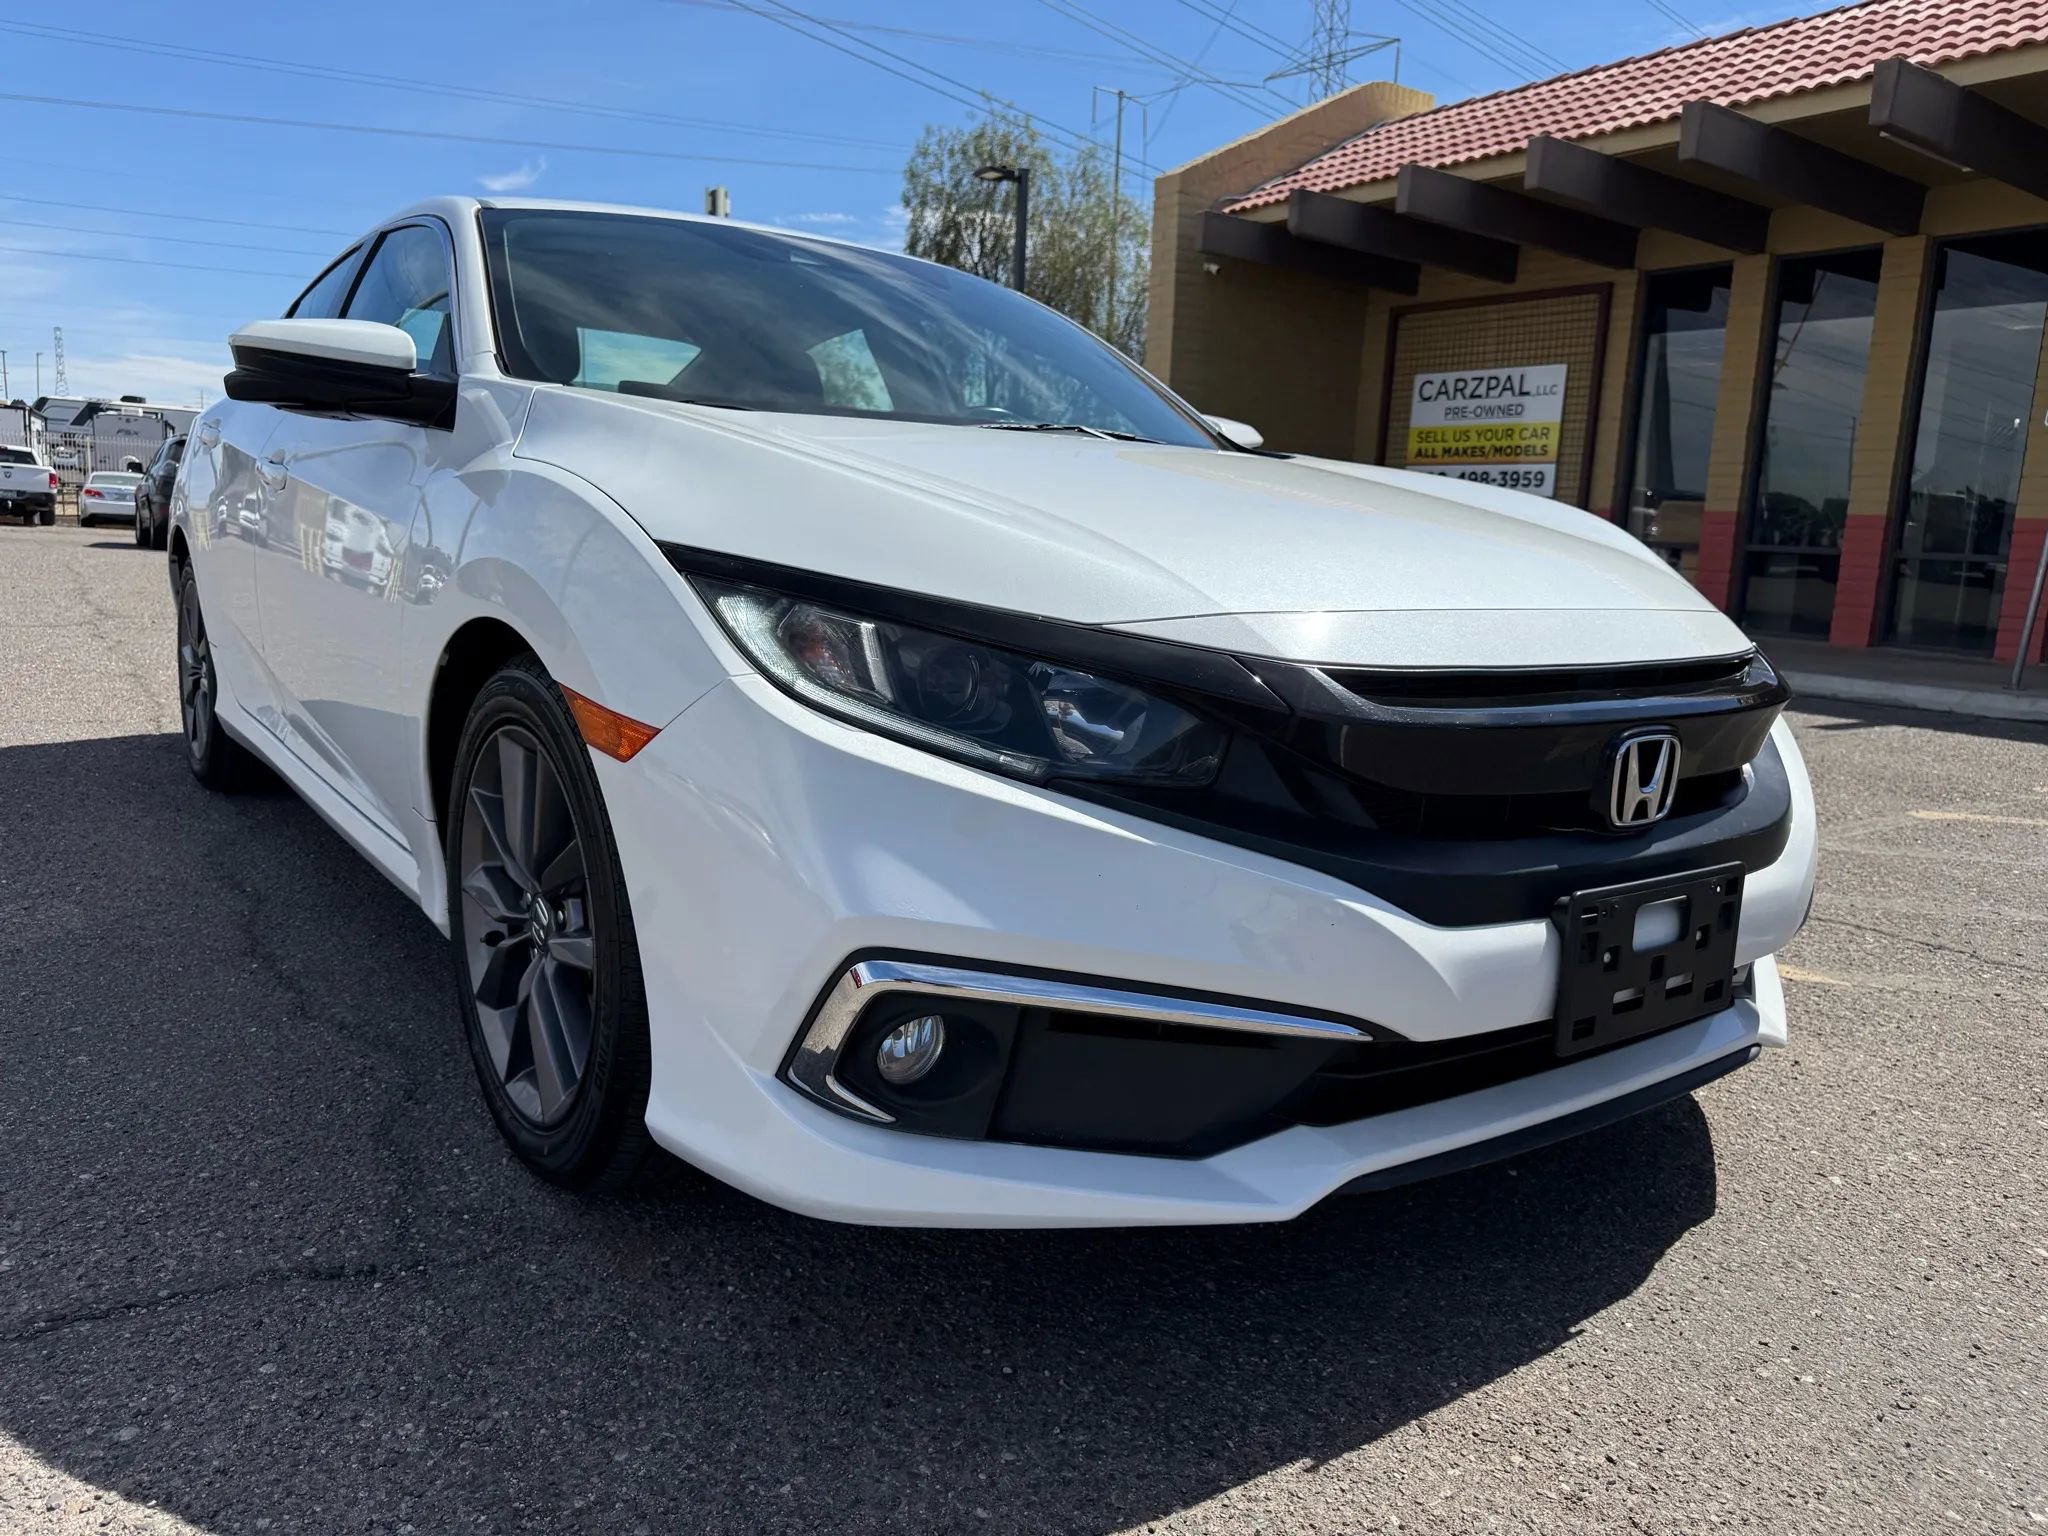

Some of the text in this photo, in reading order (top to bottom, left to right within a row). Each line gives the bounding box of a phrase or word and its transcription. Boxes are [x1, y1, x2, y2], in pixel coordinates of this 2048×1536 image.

[1418, 374, 1531, 402] CARZPAL
[1444, 403, 1525, 419] PRE-OWNED
[1416, 426, 1550, 444] SELL US YOUR CAR
[1415, 444, 1549, 460] ALL MAKES/MODELS
